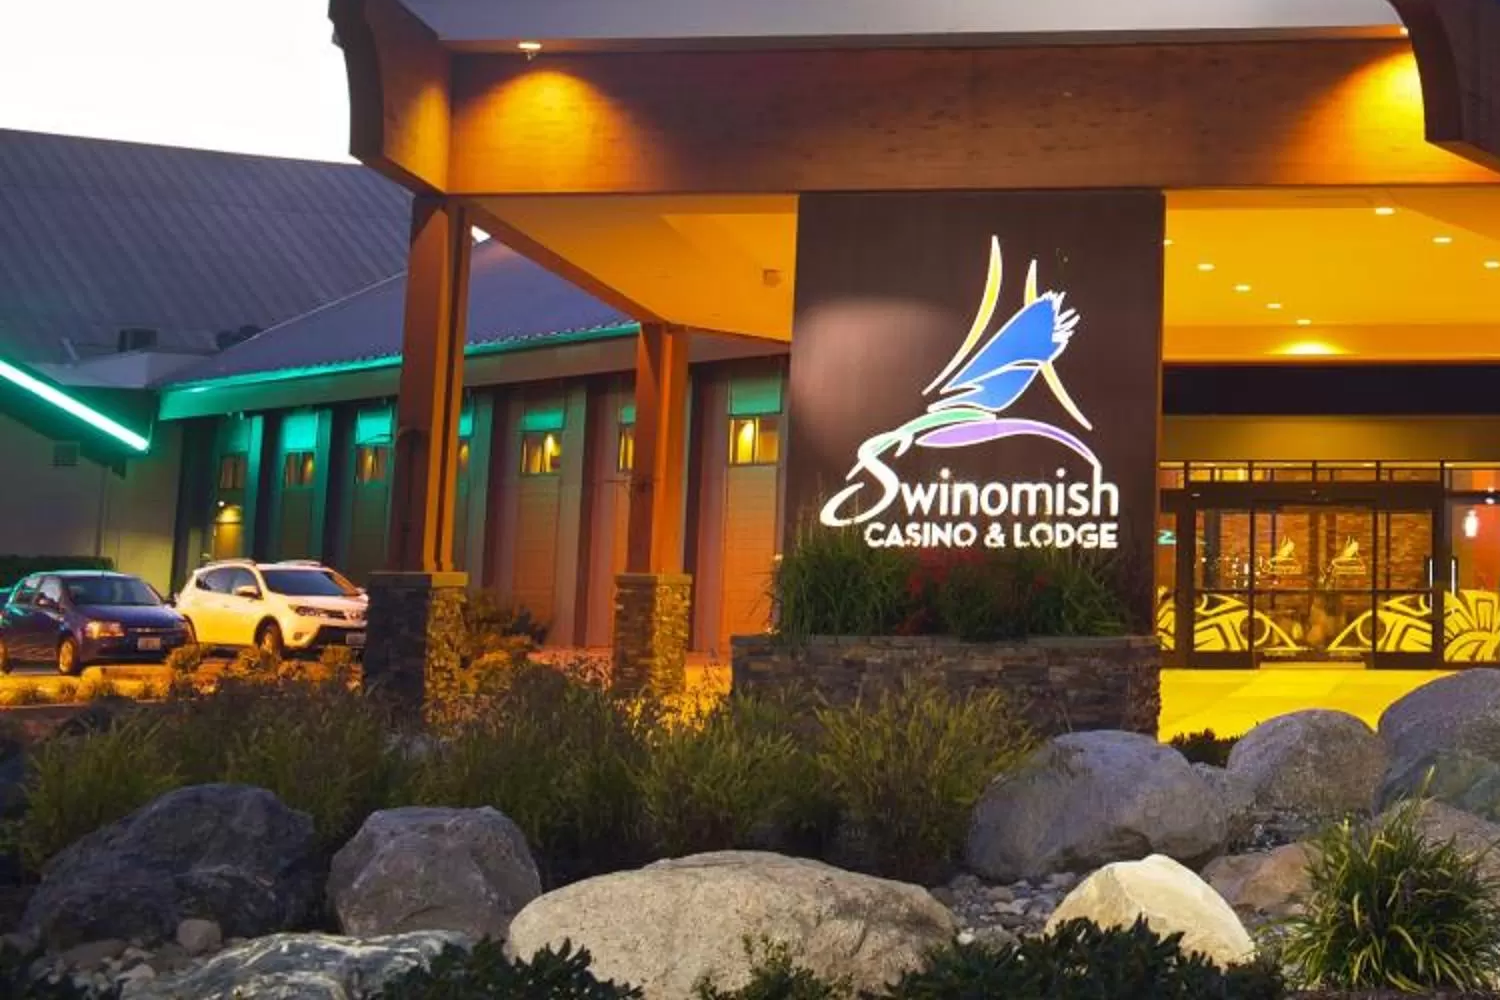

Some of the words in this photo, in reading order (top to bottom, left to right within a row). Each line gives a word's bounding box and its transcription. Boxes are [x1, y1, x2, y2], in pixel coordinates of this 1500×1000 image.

[820, 436, 1119, 527] Swinomish
[863, 521, 977, 549] CASINO
[983, 522, 1007, 549] &
[1013, 521, 1120, 549] LODGE
